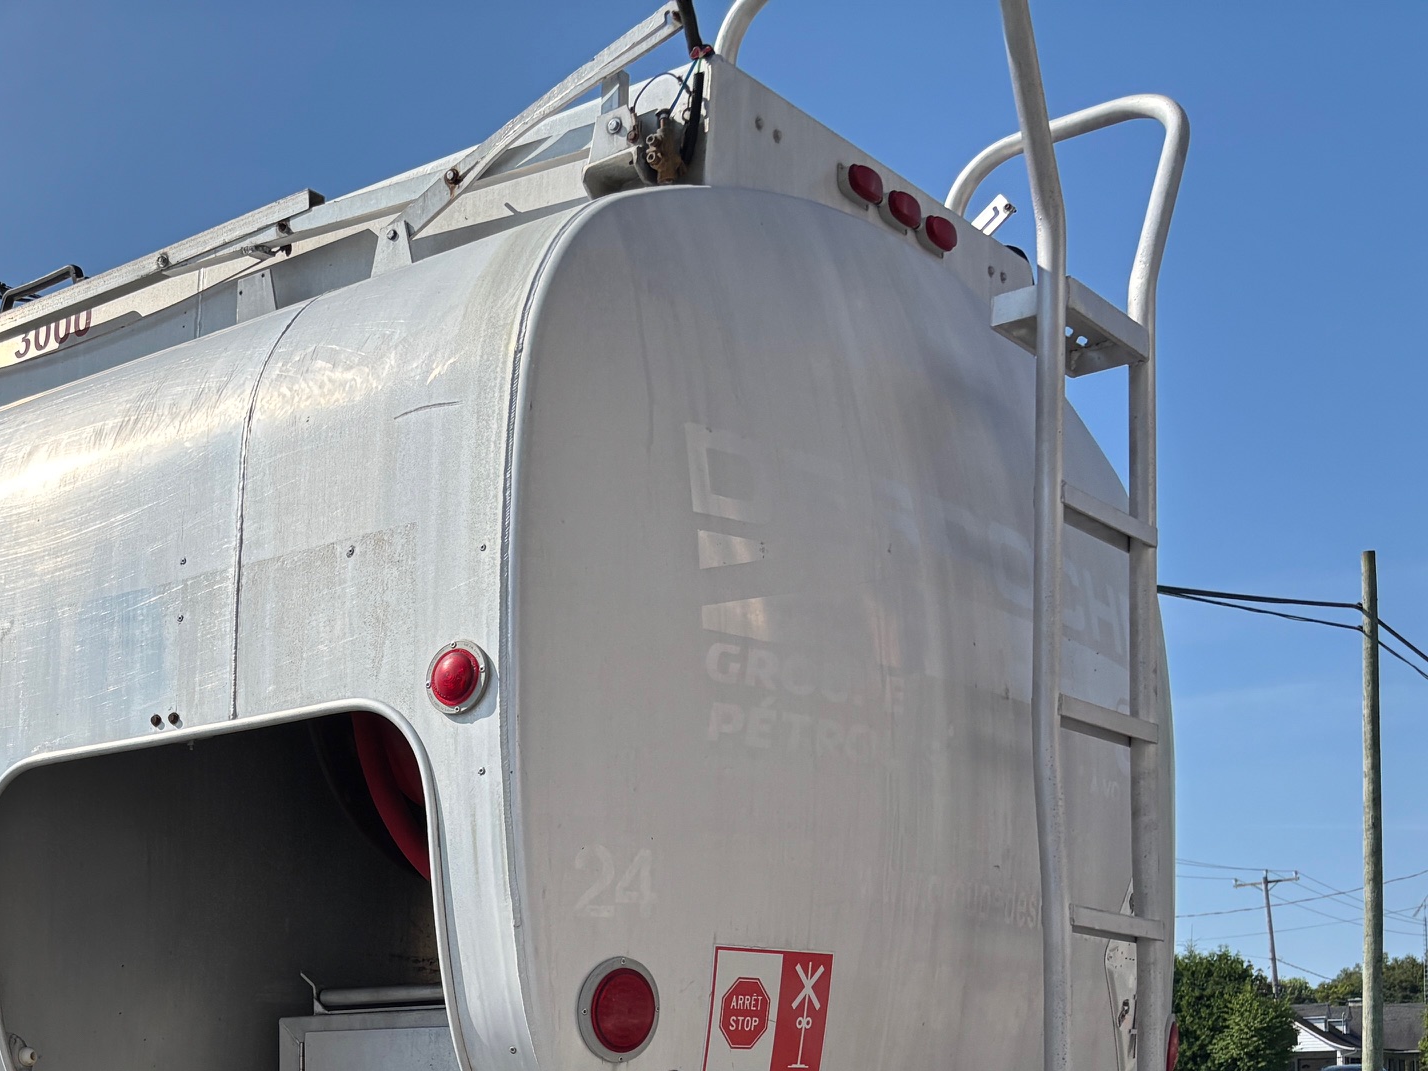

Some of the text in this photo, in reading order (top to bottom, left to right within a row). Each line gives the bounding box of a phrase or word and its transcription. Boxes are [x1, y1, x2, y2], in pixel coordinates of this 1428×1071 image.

[14, 309, 92, 359] 3000
[572, 845, 658, 919] 24
[730, 993, 763, 1011] ARRÊT
[728, 1016, 760, 1031] STOP
